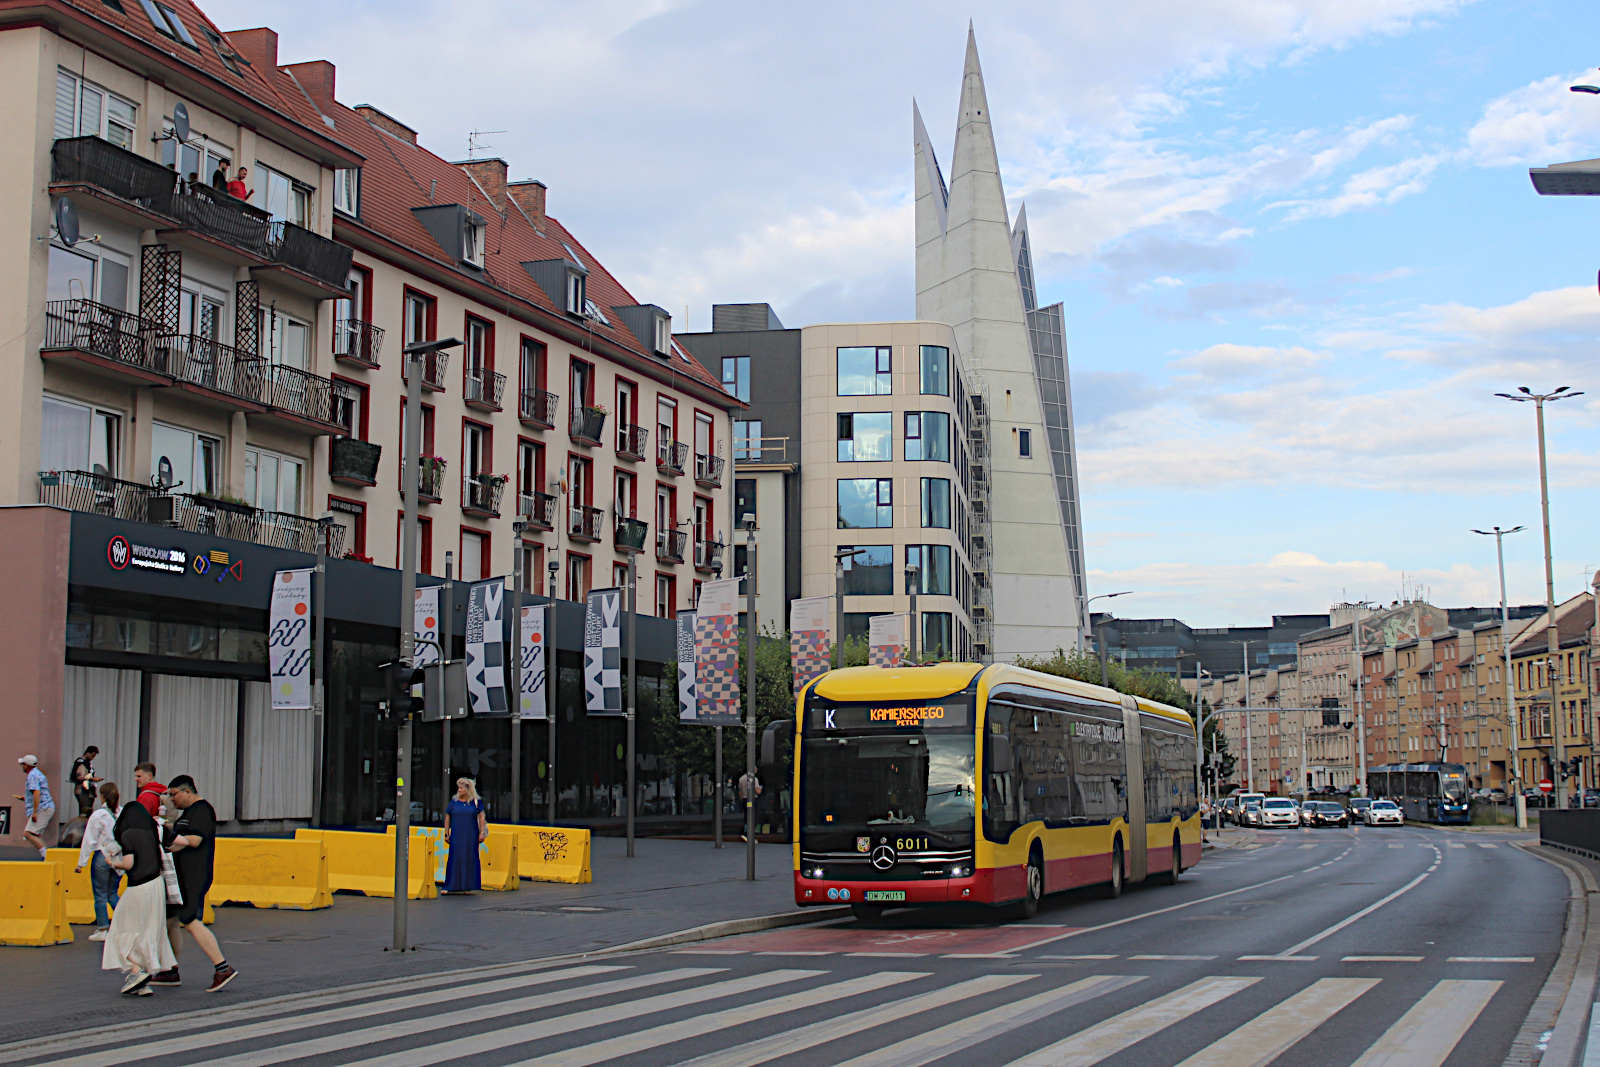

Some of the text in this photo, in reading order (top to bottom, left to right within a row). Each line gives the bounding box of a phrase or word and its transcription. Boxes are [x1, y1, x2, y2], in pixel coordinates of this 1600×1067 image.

[132, 544, 186, 563] WROCŁAW 2016
[269, 618, 307, 647] 60
[272, 649, 311, 677] 10
[825, 707, 944, 729] K KAMIEŃSKIEGO
[896, 838, 928, 850] 6011
